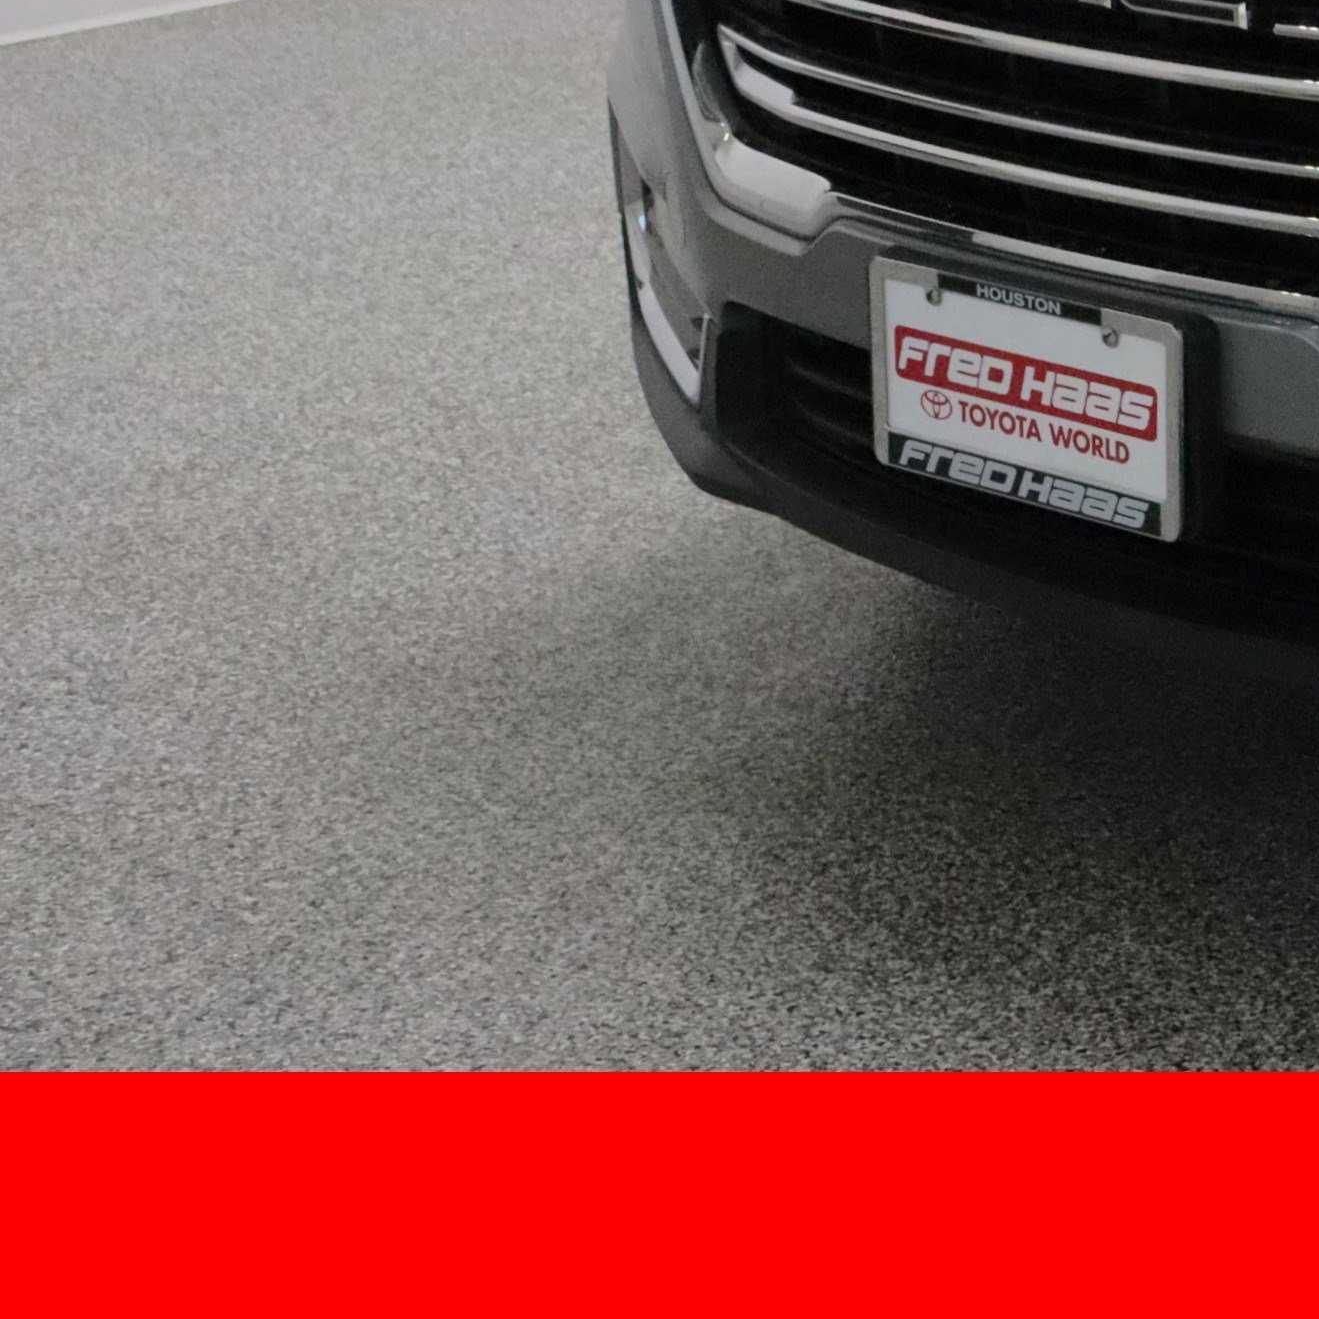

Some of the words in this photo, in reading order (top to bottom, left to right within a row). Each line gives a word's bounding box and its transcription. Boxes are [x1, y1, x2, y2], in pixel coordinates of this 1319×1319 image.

[975, 283, 1062, 316] HOUSTON
[959, 399, 1042, 442] TOYOTA
[1048, 422, 1130, 464] WORLD
